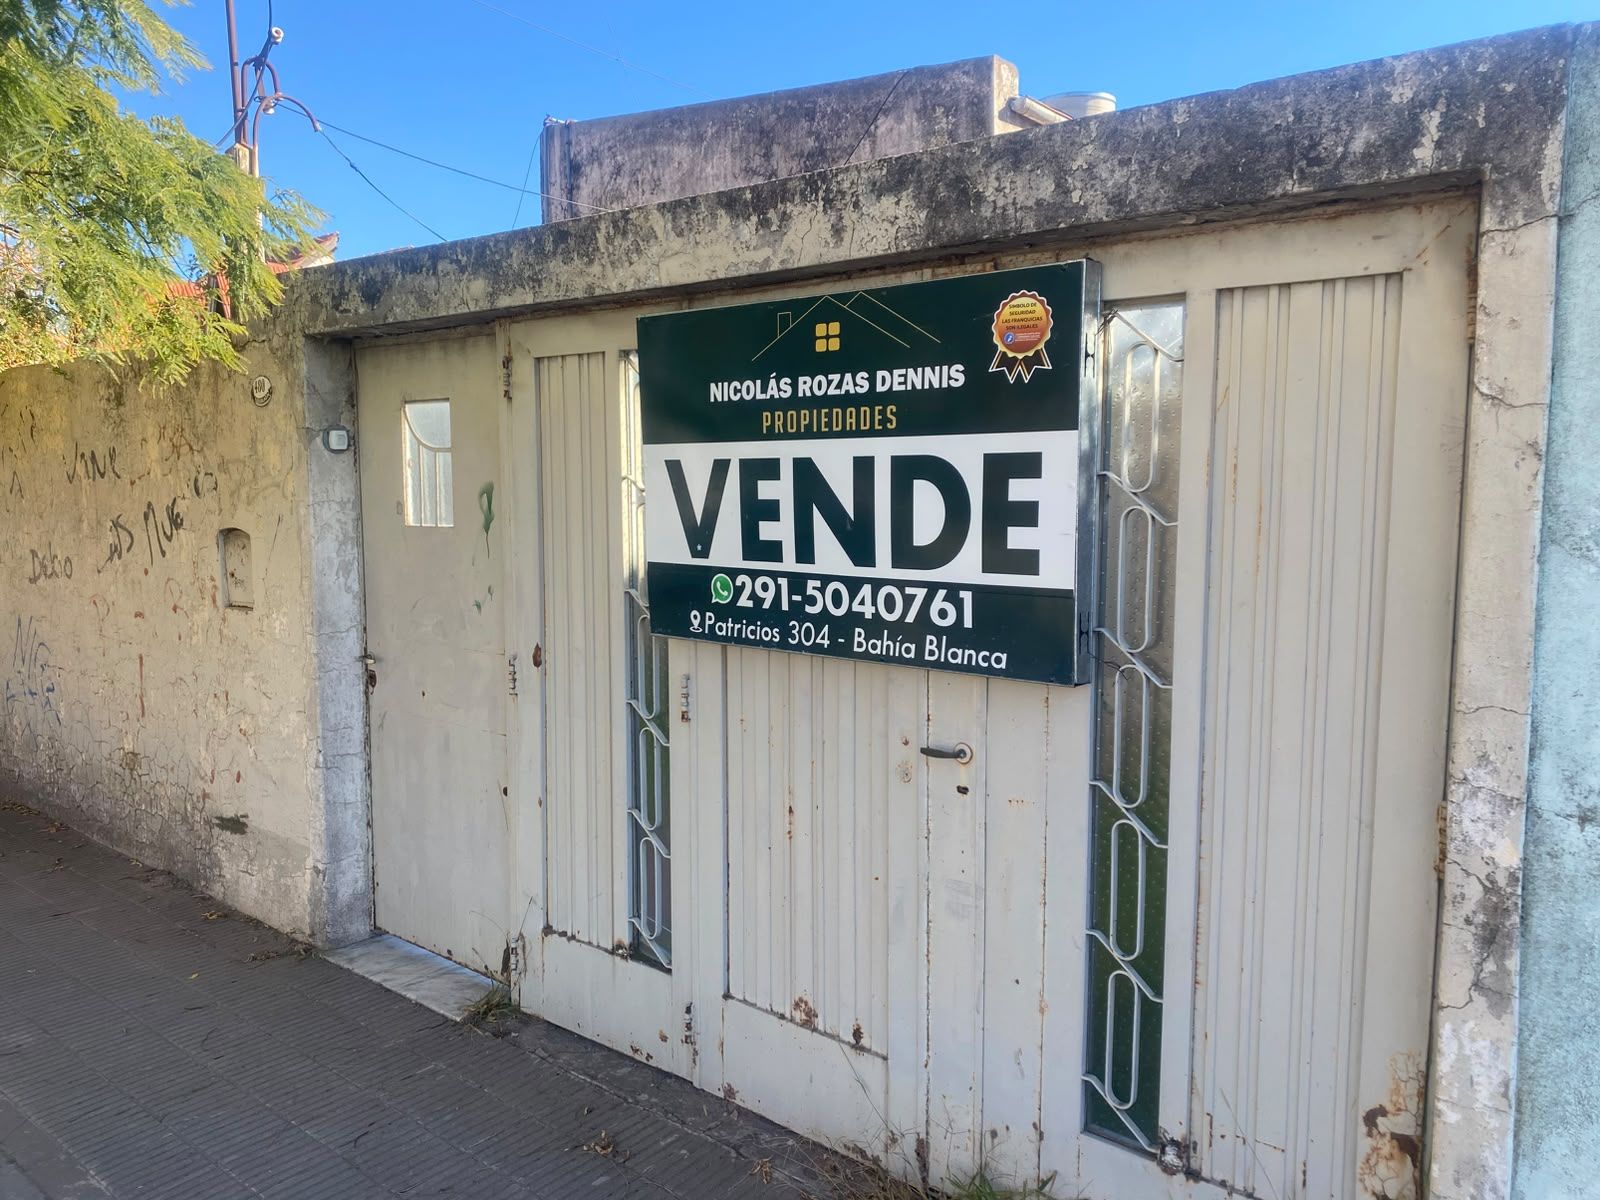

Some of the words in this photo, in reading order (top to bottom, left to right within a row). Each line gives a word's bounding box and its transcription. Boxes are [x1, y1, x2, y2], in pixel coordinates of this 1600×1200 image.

[709, 372, 792, 402] NICOLÁS
[797, 370, 870, 397] ROZAS
[875, 363, 966, 392] DENNIS
[762, 404, 898, 434] PROPIEDADES
[664, 451, 1043, 576] VENDE
[734, 574, 974, 629] 291-5040761
[704, 611, 781, 643] Patricios
[787, 620, 831, 649] 304
[852, 626, 917, 660] Bahía
[923, 634, 1008, 670] Blanca
